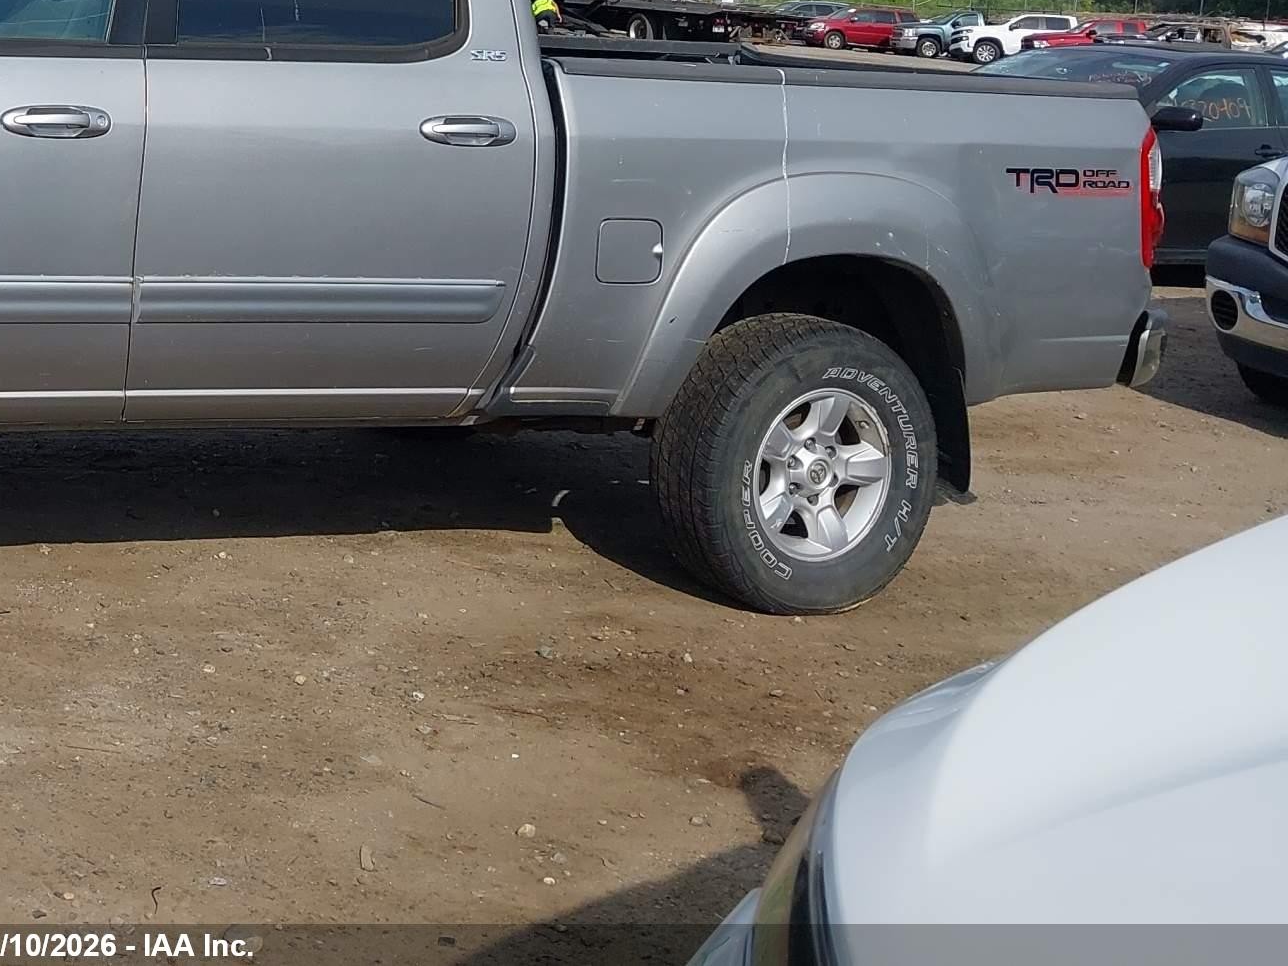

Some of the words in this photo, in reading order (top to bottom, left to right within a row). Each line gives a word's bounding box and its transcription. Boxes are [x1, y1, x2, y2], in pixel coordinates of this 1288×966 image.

[1005, 167, 1080, 194] TRD
[1082, 168, 1119, 178] OFF
[1082, 180, 1130, 189] ROAD
[821, 366, 921, 489] ADVENTURER
[884, 498, 913, 553] H/T
[740, 458, 794, 581] COOPER
